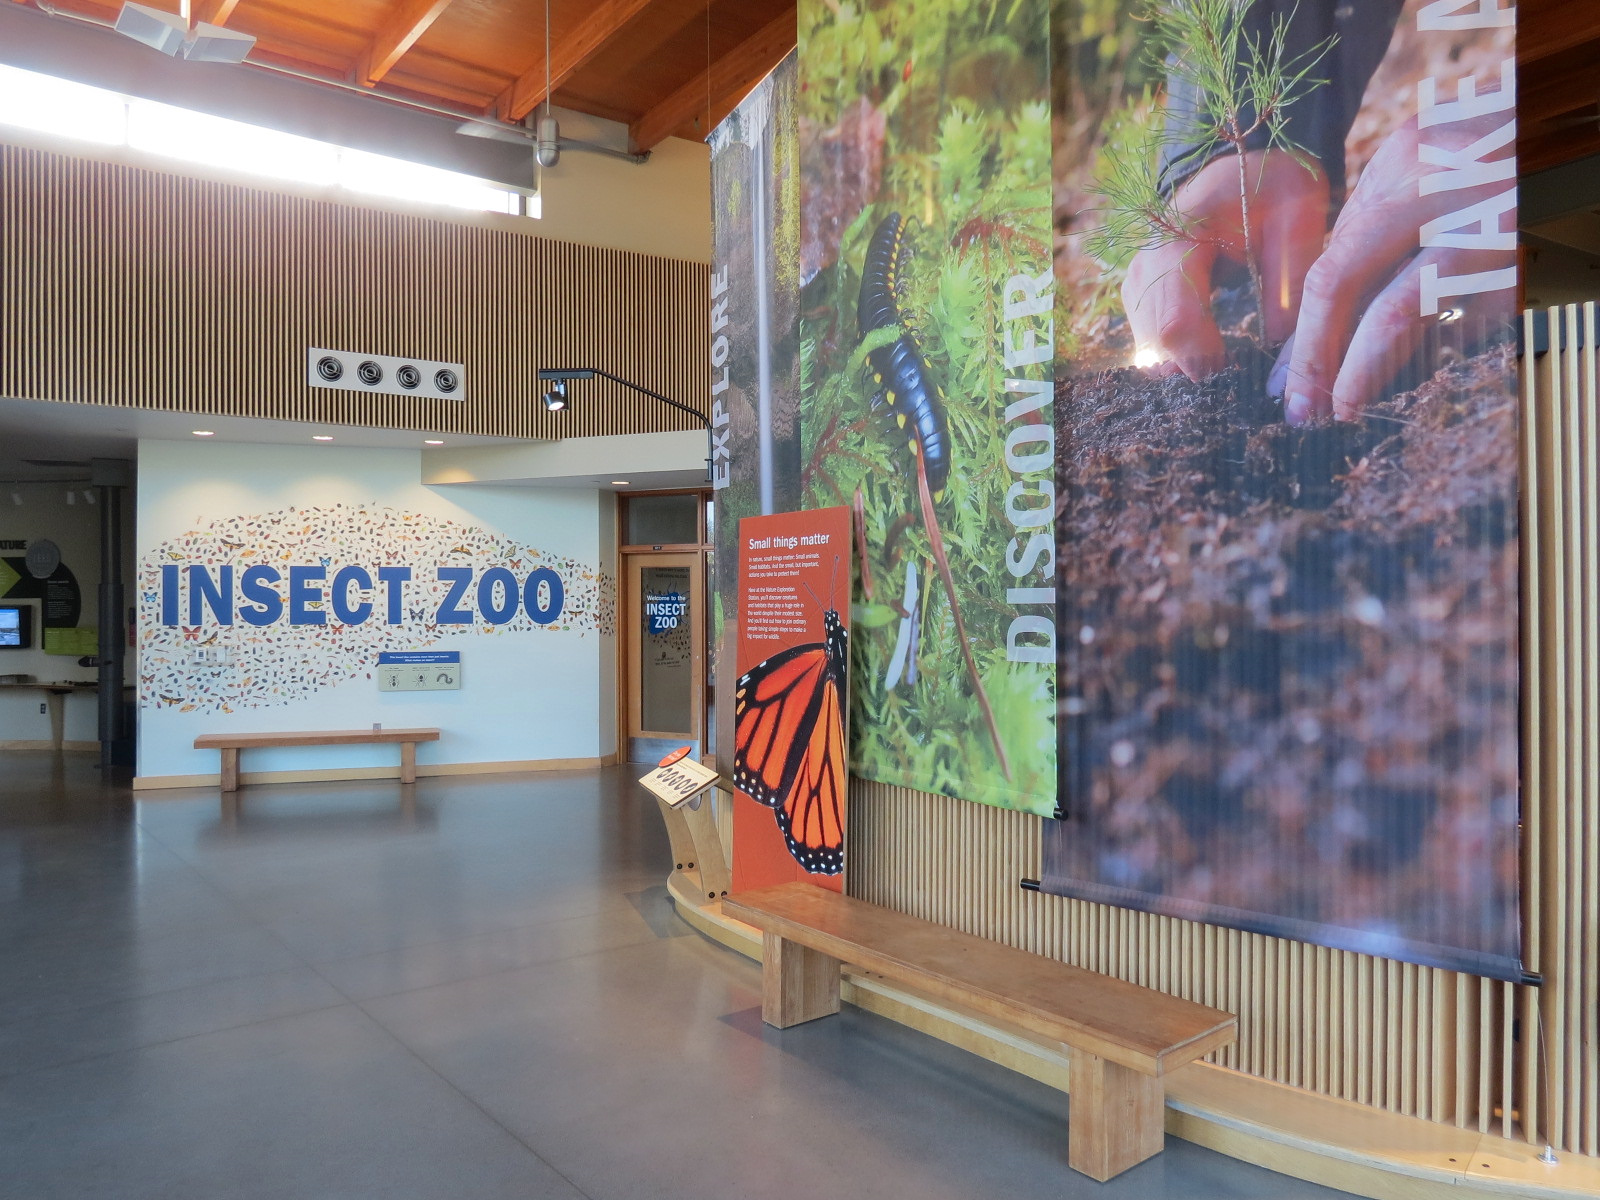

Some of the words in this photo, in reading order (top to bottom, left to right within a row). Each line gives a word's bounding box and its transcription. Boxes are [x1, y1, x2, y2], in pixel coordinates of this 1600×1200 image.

[1417, 57, 1518, 318] TAKE
[711, 264, 730, 490] EXPLORE
[1004, 265, 1056, 664] DISCOVER
[749, 537, 770, 549] Small
[774, 536, 798, 549] things
[801, 534, 829, 545] matter
[162, 564, 410, 626] INSECT
[436, 567, 565, 625] ZOO
[646, 604, 686, 615] INSECT
[655, 617, 677, 628] ZOO
